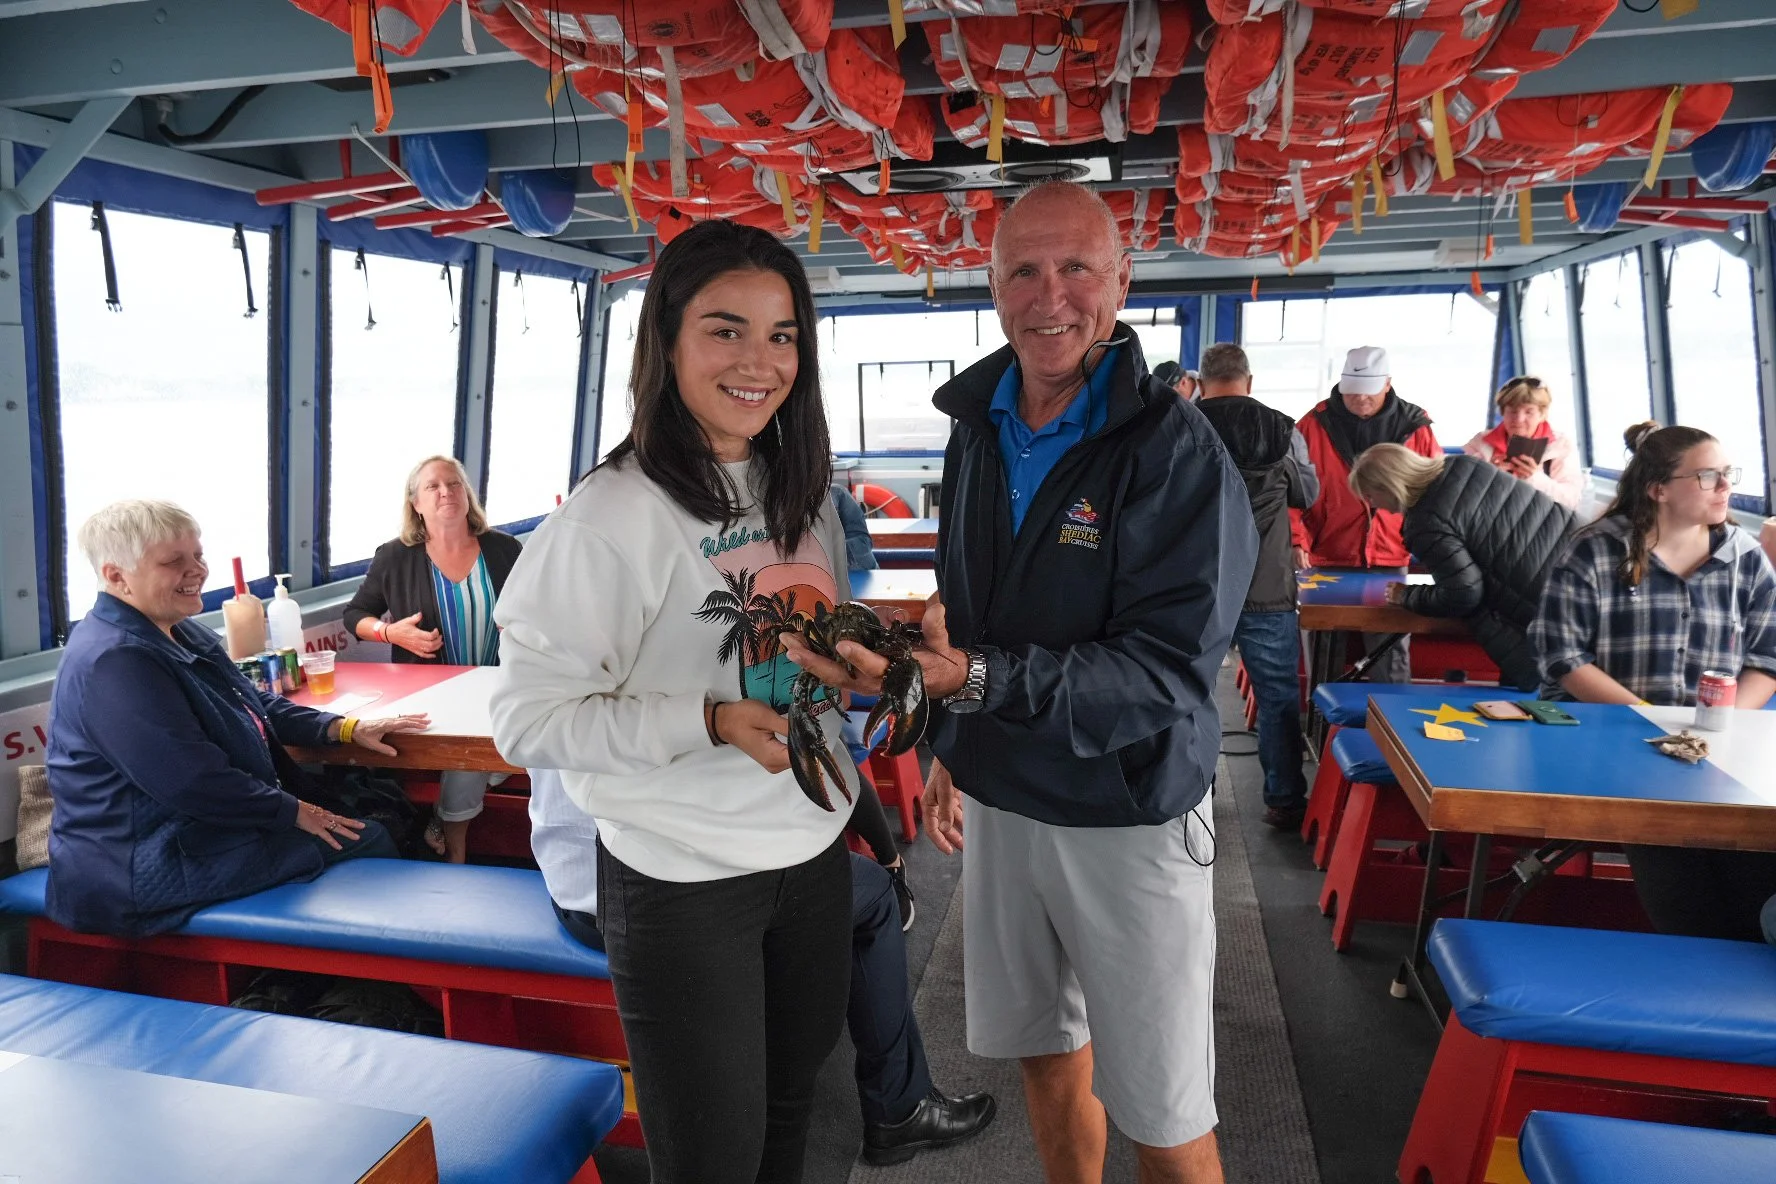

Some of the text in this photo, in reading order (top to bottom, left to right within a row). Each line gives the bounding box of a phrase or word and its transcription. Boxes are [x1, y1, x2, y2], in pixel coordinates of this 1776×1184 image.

[700, 526, 750, 558] Wild
[1061, 530, 1102, 544] SHEDIAC
[1070, 538, 1099, 550] CRUISES
